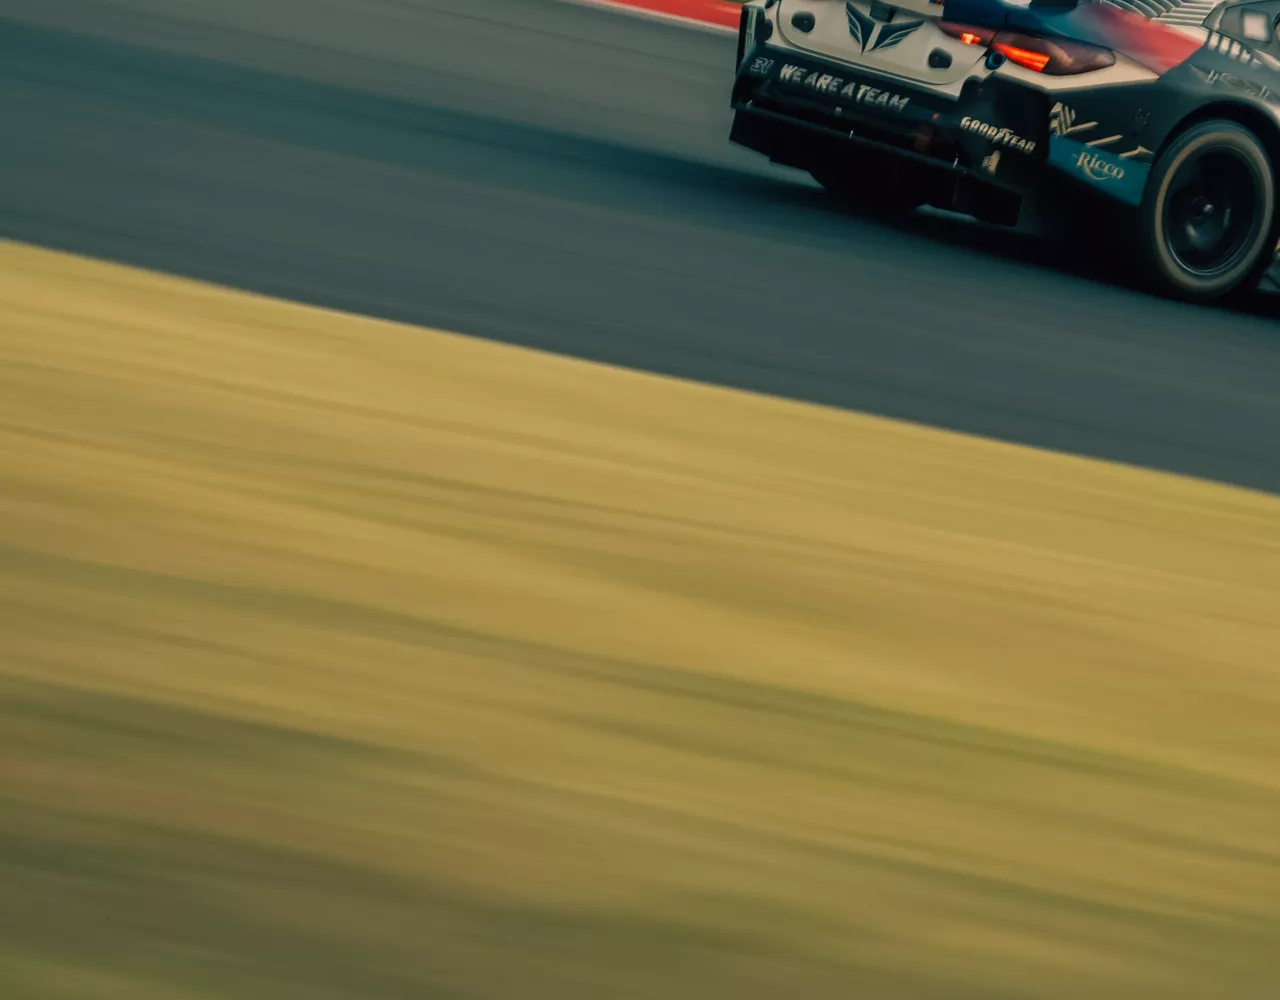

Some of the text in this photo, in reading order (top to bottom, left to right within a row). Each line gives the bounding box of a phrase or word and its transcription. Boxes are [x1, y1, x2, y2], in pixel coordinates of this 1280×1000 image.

[780, 63, 910, 112] WE ARE A TEAM
[960, 115, 1037, 152] GOODYEAR
